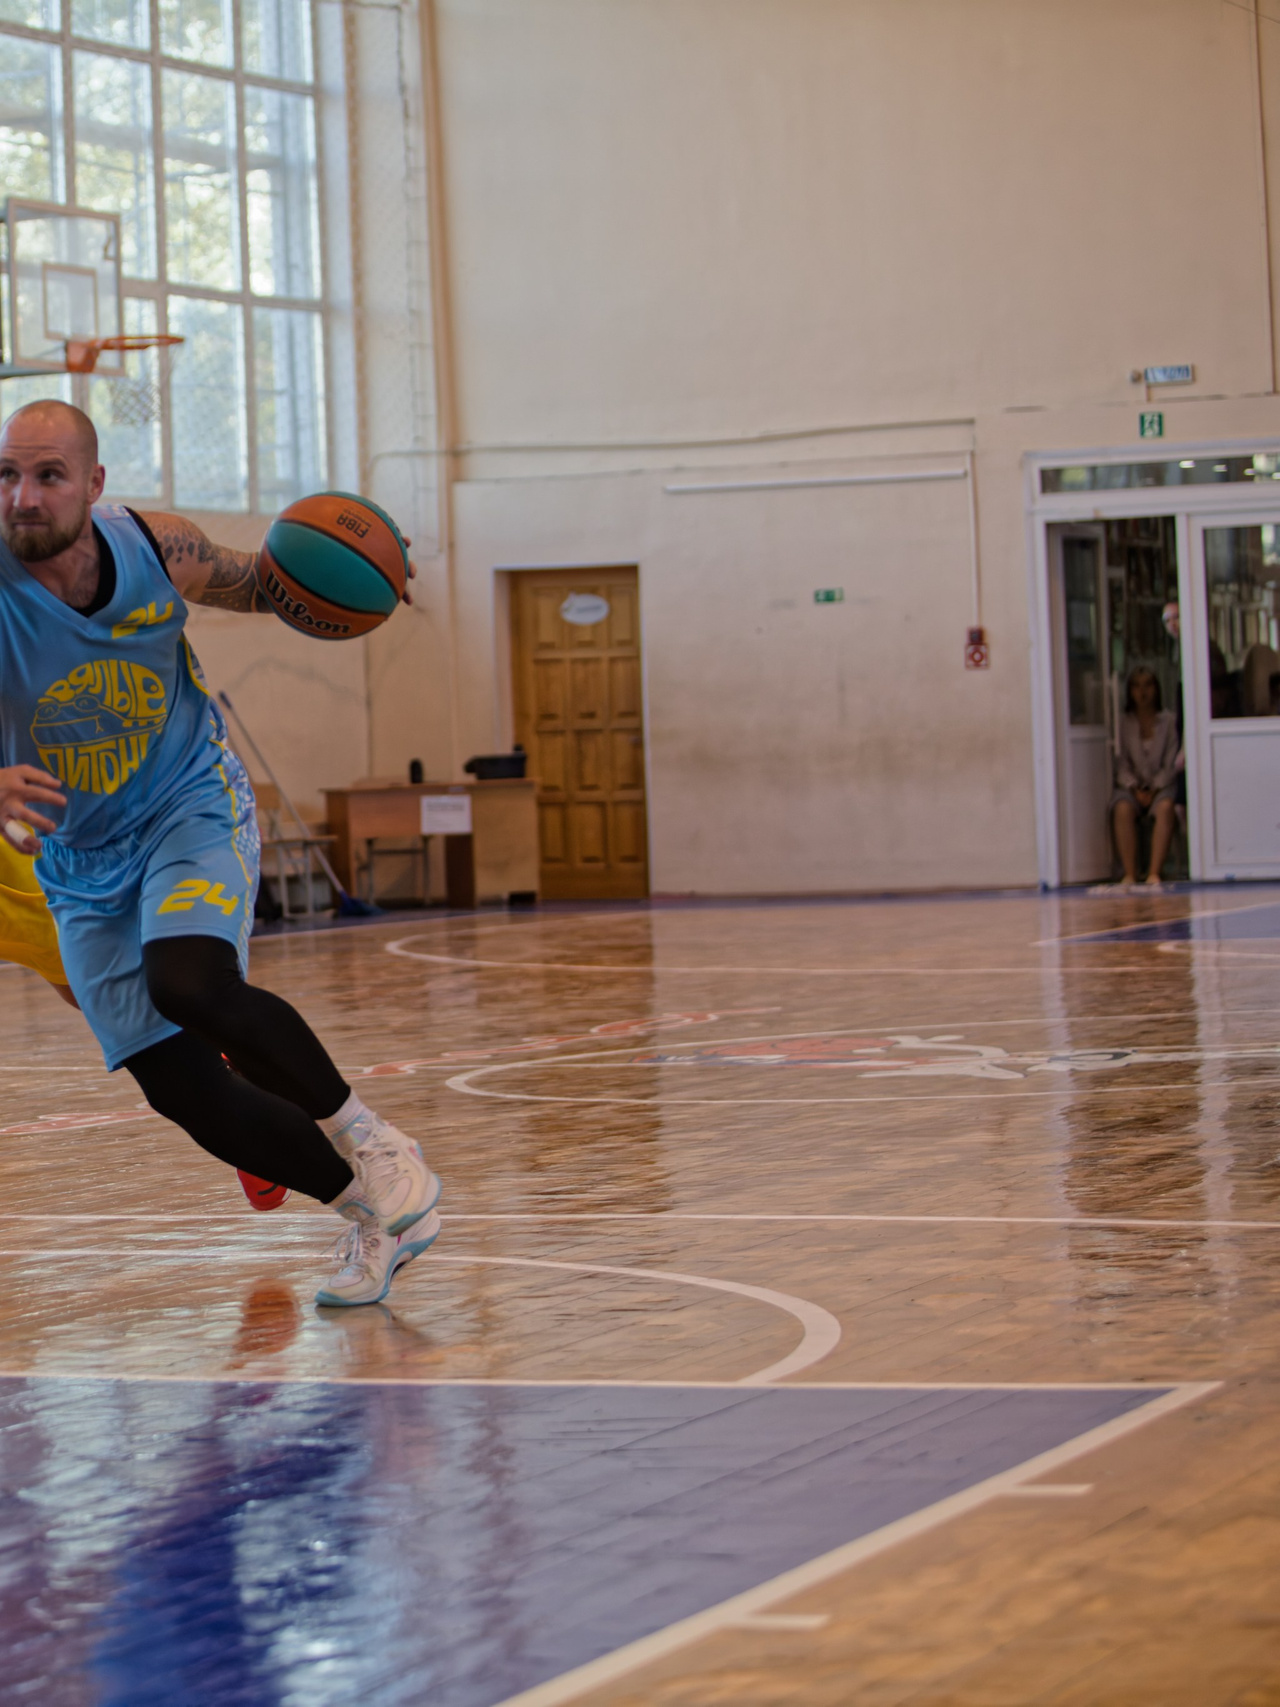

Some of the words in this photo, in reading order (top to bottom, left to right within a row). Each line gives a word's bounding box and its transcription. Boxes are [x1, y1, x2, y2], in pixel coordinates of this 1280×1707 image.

[336, 513, 370, 539] FIBA
[111, 601, 174, 639] 24
[266, 569, 352, 634] Wilson
[156, 879, 239, 916] 24
